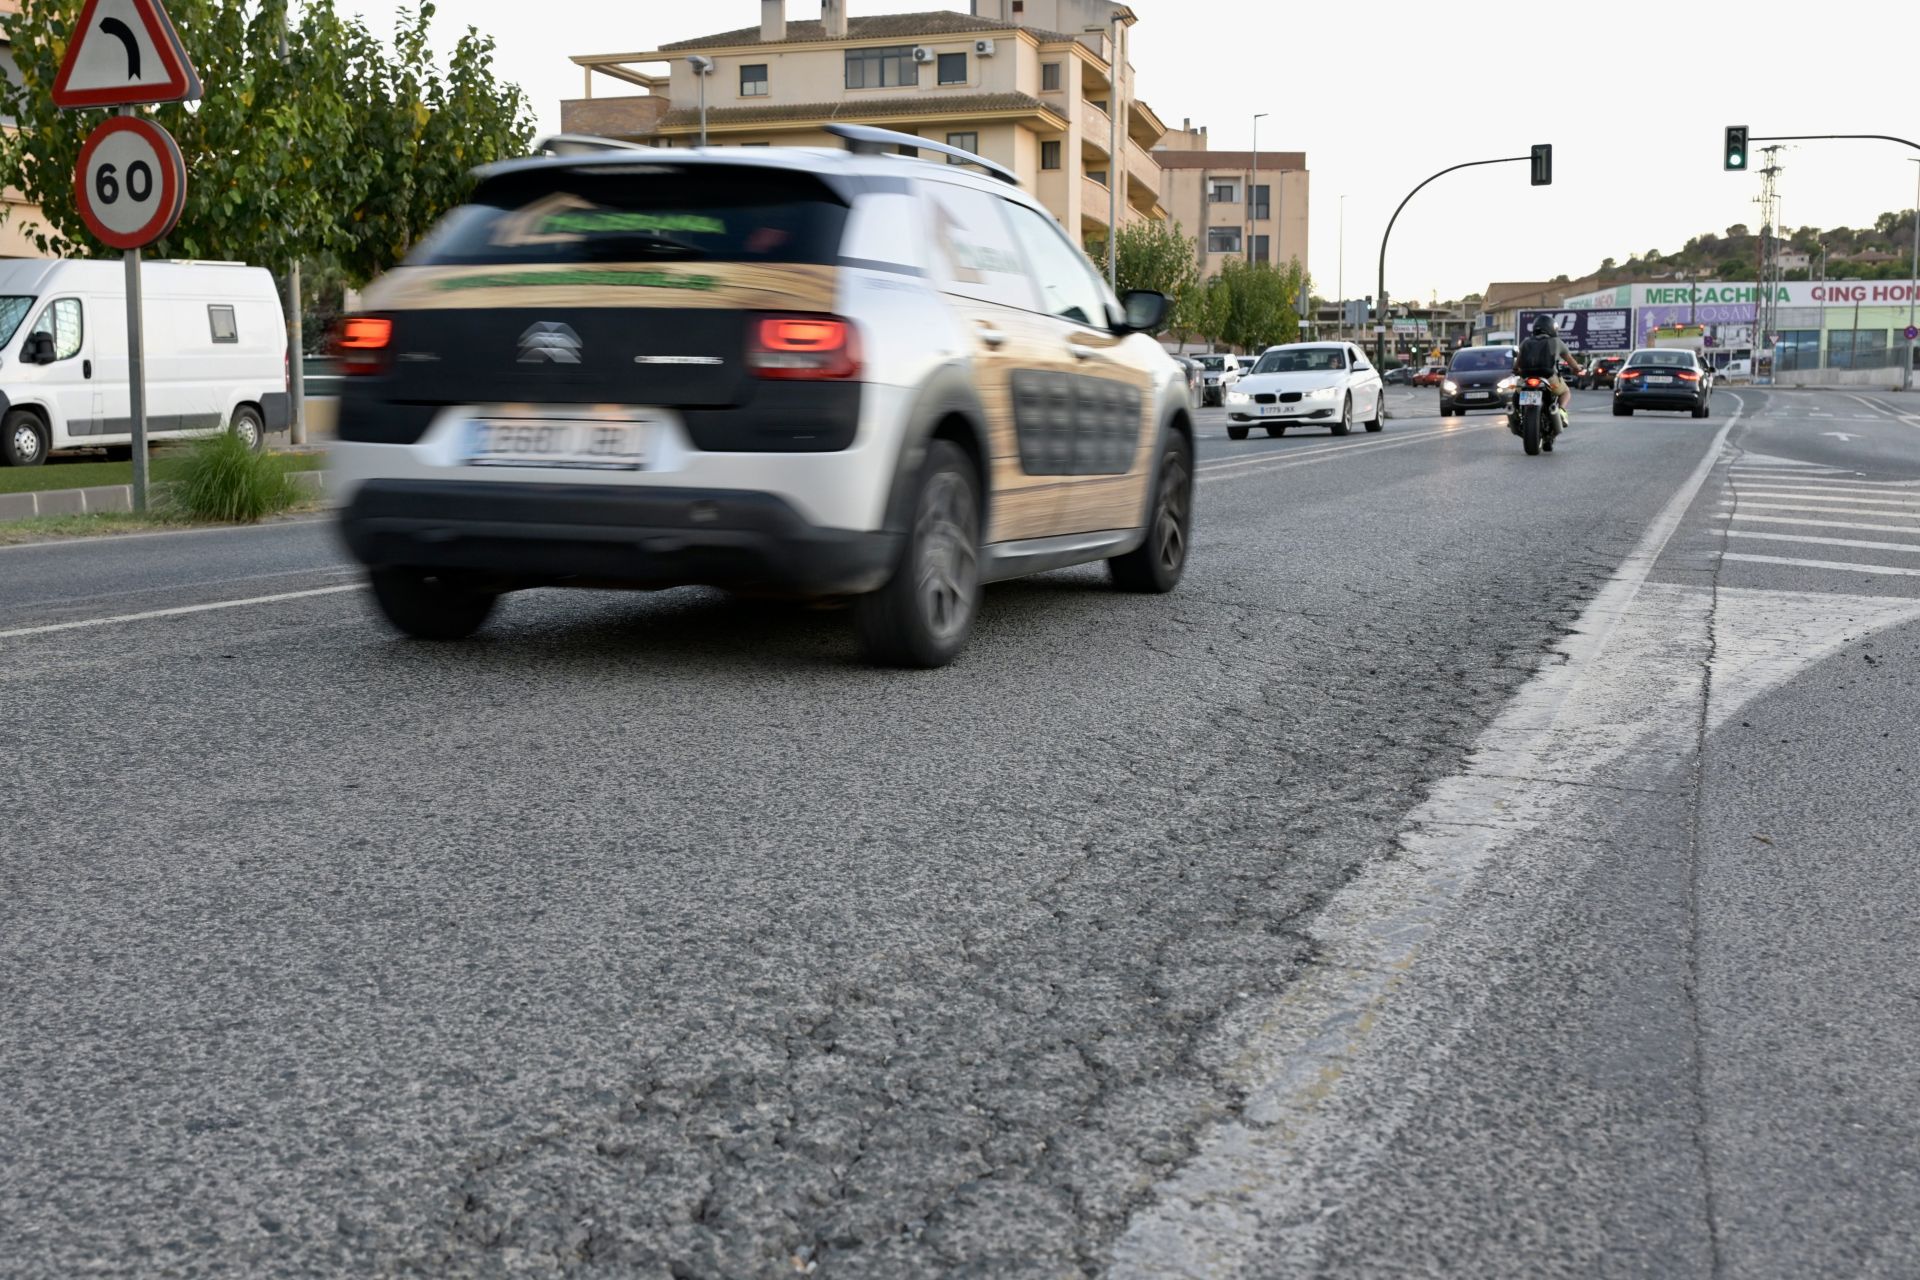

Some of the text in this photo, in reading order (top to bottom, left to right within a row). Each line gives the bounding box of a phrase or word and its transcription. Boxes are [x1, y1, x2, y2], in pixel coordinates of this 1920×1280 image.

[96, 160, 153, 205] 60
[1645, 286, 1791, 304] MERCACHINA
[1811, 286, 1866, 302] QING
